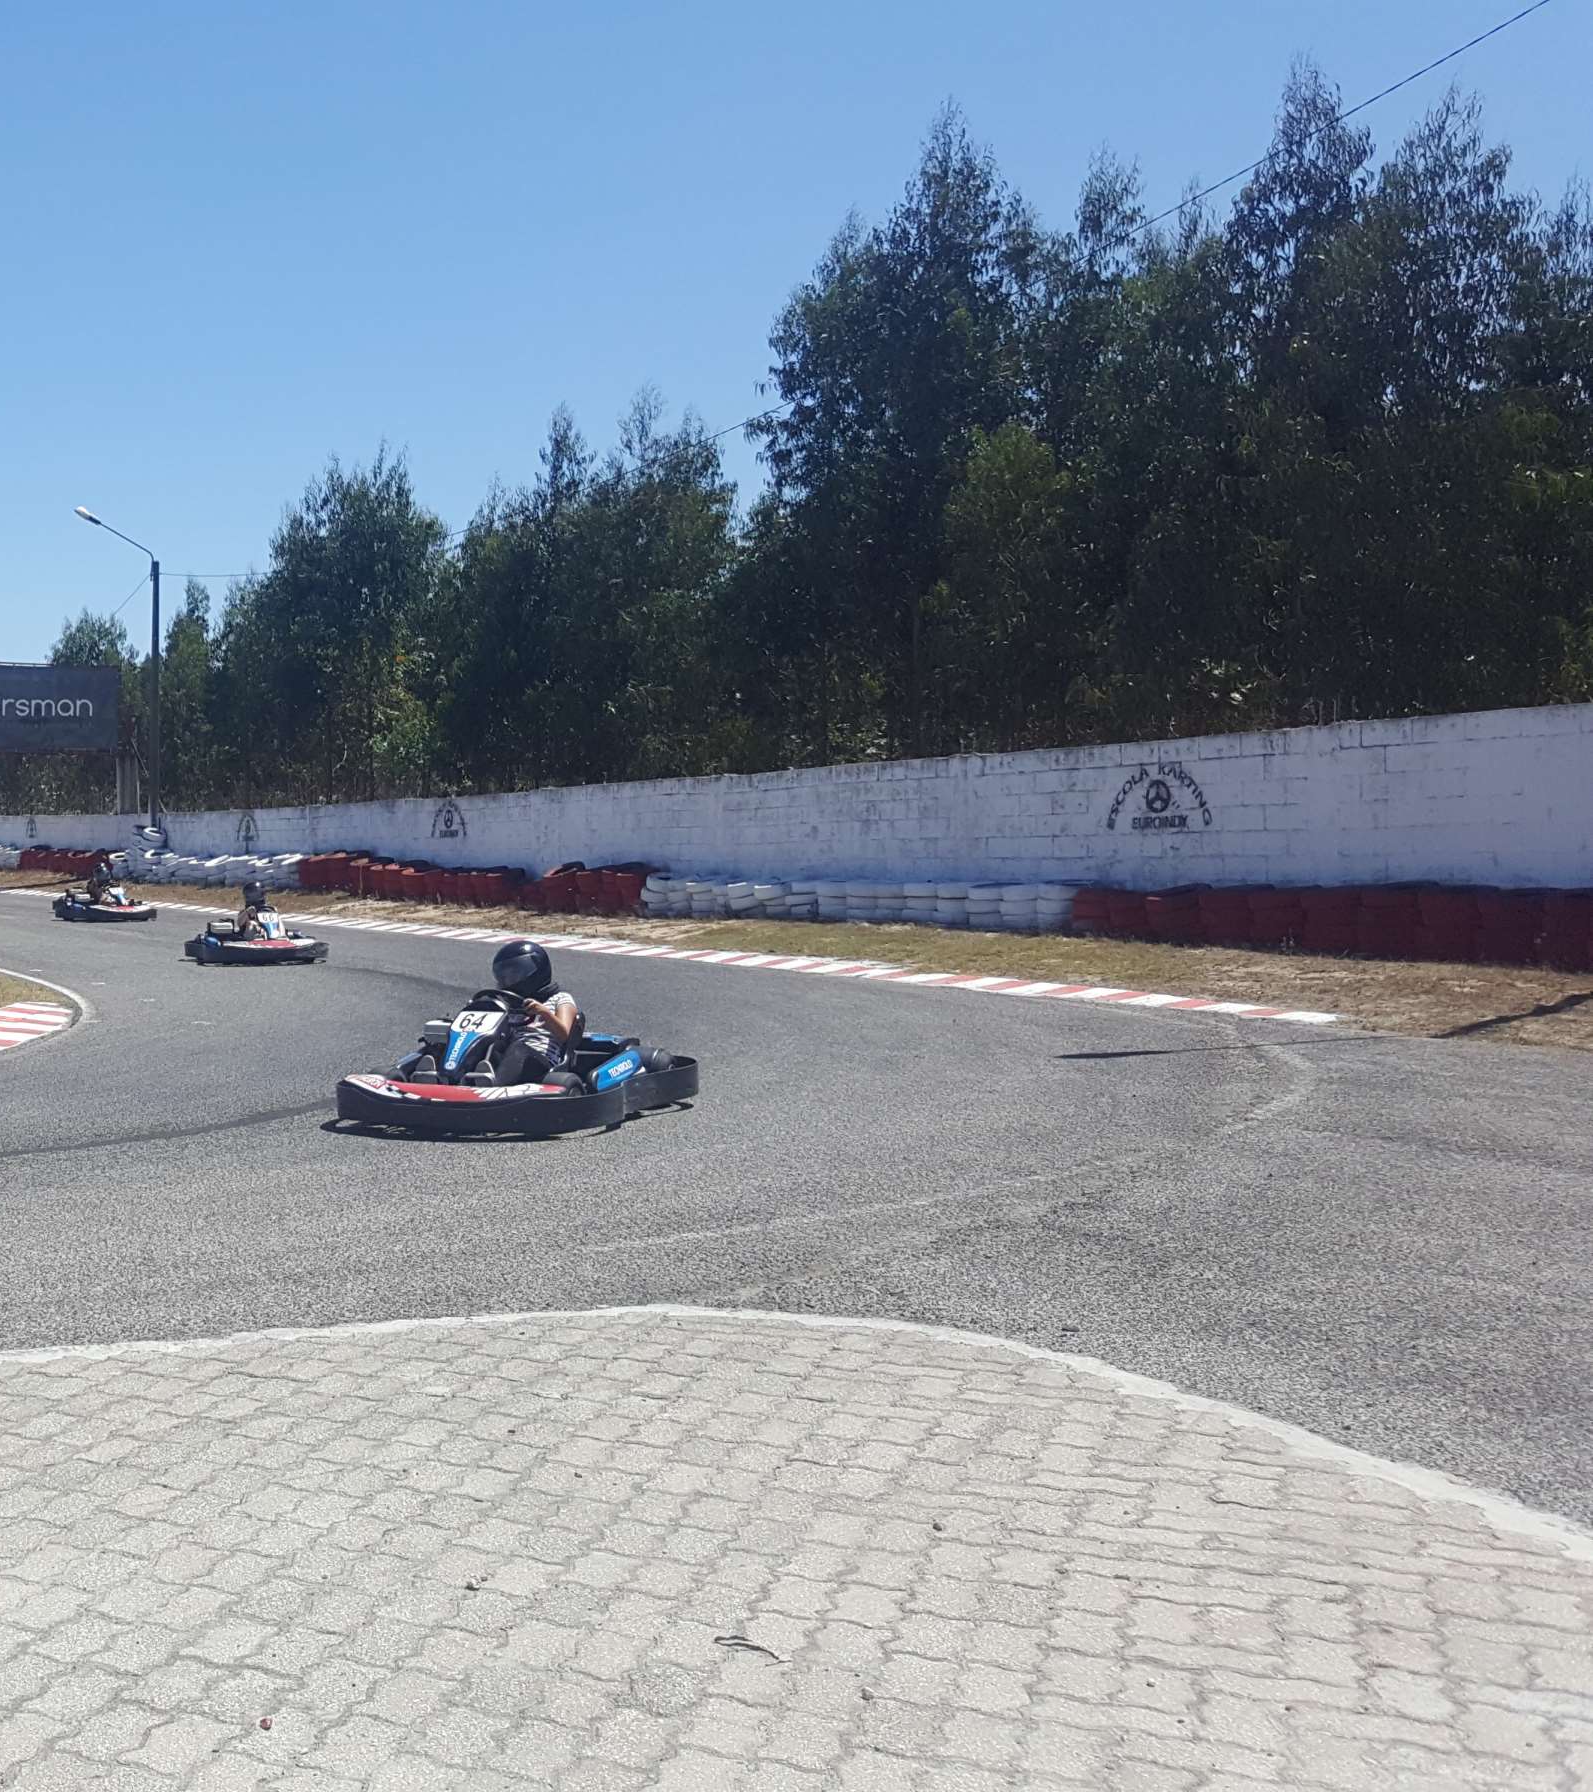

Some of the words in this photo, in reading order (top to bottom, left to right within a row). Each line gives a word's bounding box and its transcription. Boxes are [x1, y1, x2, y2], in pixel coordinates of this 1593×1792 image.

[1107, 765, 1149, 830] ESCOLA
[1158, 763, 1212, 826] KARTING
[1132, 815, 1188, 829] EUROINDY
[459, 1013, 488, 1029] 64
